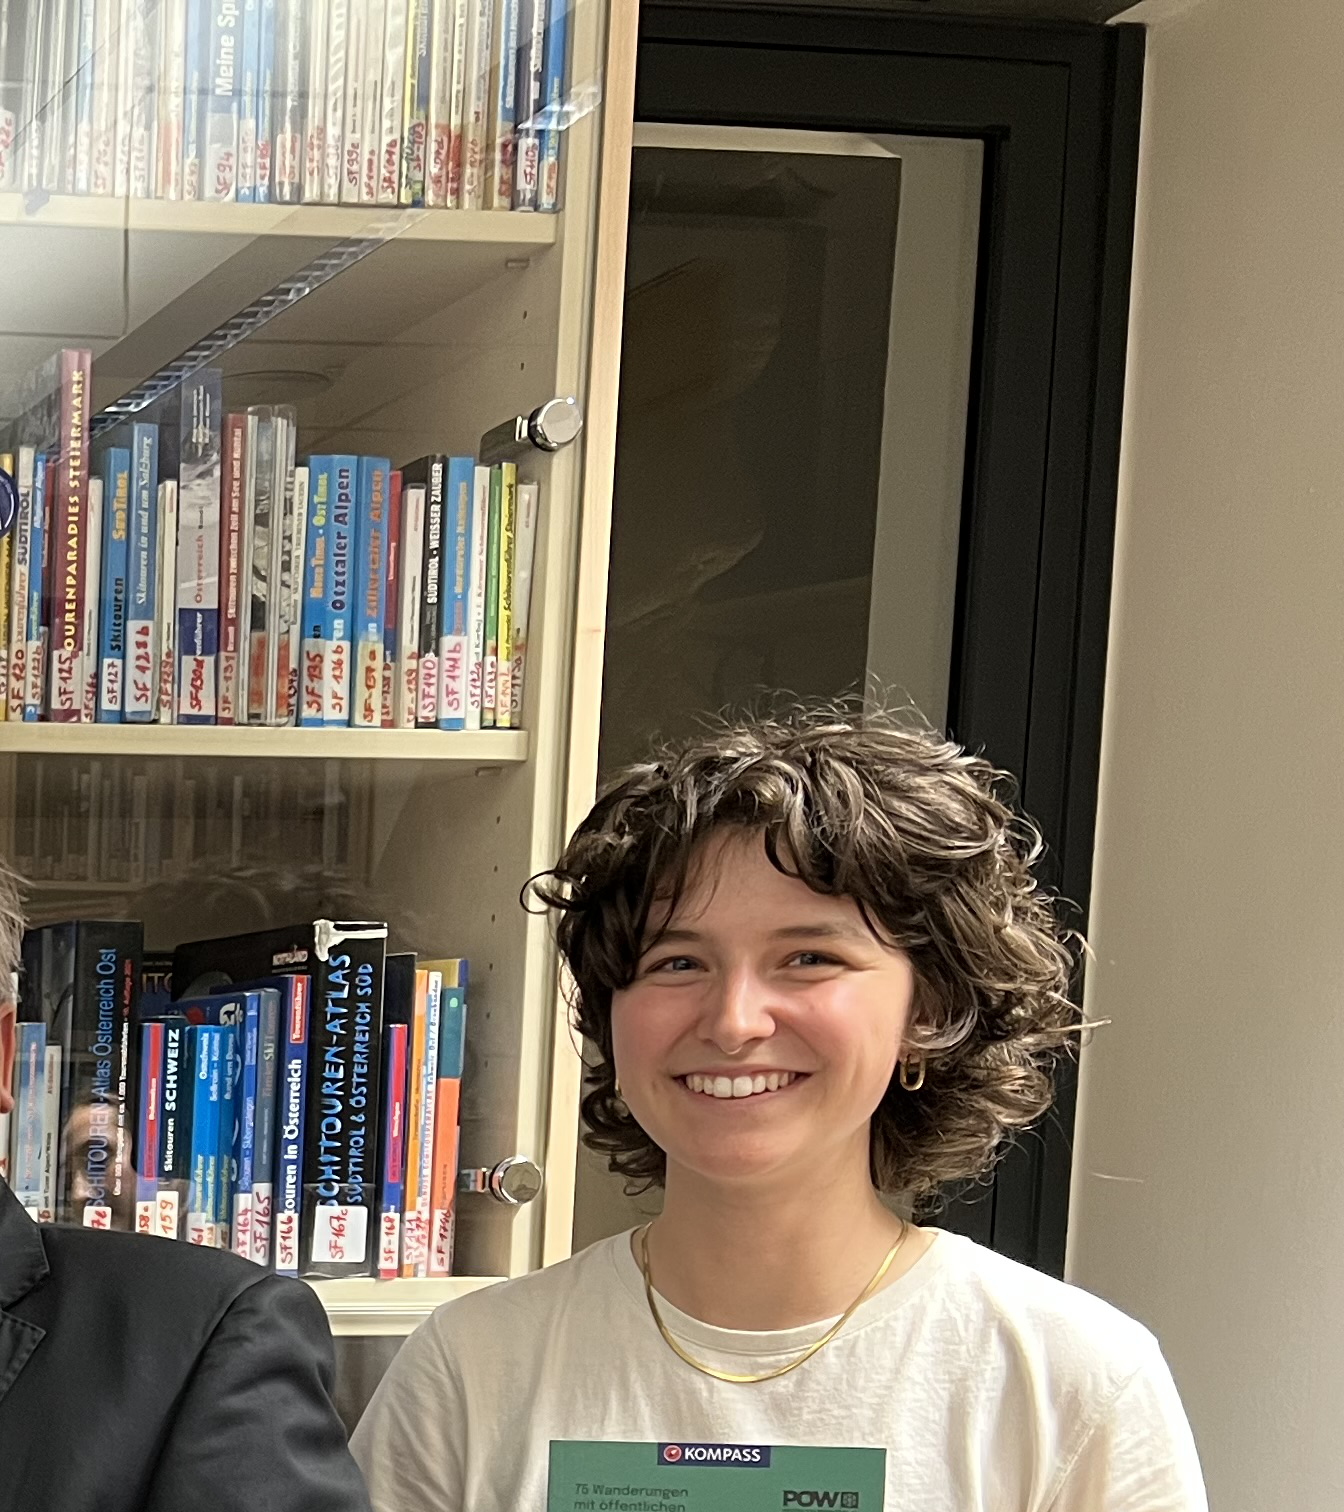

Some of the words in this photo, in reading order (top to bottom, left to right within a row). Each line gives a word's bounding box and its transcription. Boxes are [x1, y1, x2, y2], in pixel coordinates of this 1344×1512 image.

[215, 34, 235, 97] Meine
[68, 370, 84, 489] STEIERMARK
[334, 466, 350, 526] Alpen
[430, 502, 442, 550] WEISSER
[63, 495, 80, 653] OURENPARADIES
[427, 556, 440, 604] SÜDTIROL
[112, 576, 124, 652] Skitouren
[96, 947, 118, 977] Ost
[92, 977, 115, 1055] Österreich
[166, 1028, 181, 1112] SCHWEIZ
[282, 1058, 303, 1140] Österreich
[163, 1117, 176, 1173] Skitouren
[284, 1144, 297, 1161] in
[284, 1164, 297, 1215] touren
[684, 1446, 761, 1462] KOMPASS
[573, 1500, 595, 1511] mit
[599, 1500, 686, 1512] öffentlichen
[592, 1484, 689, 1499] Wanderungen
[782, 1490, 841, 1509] POW
